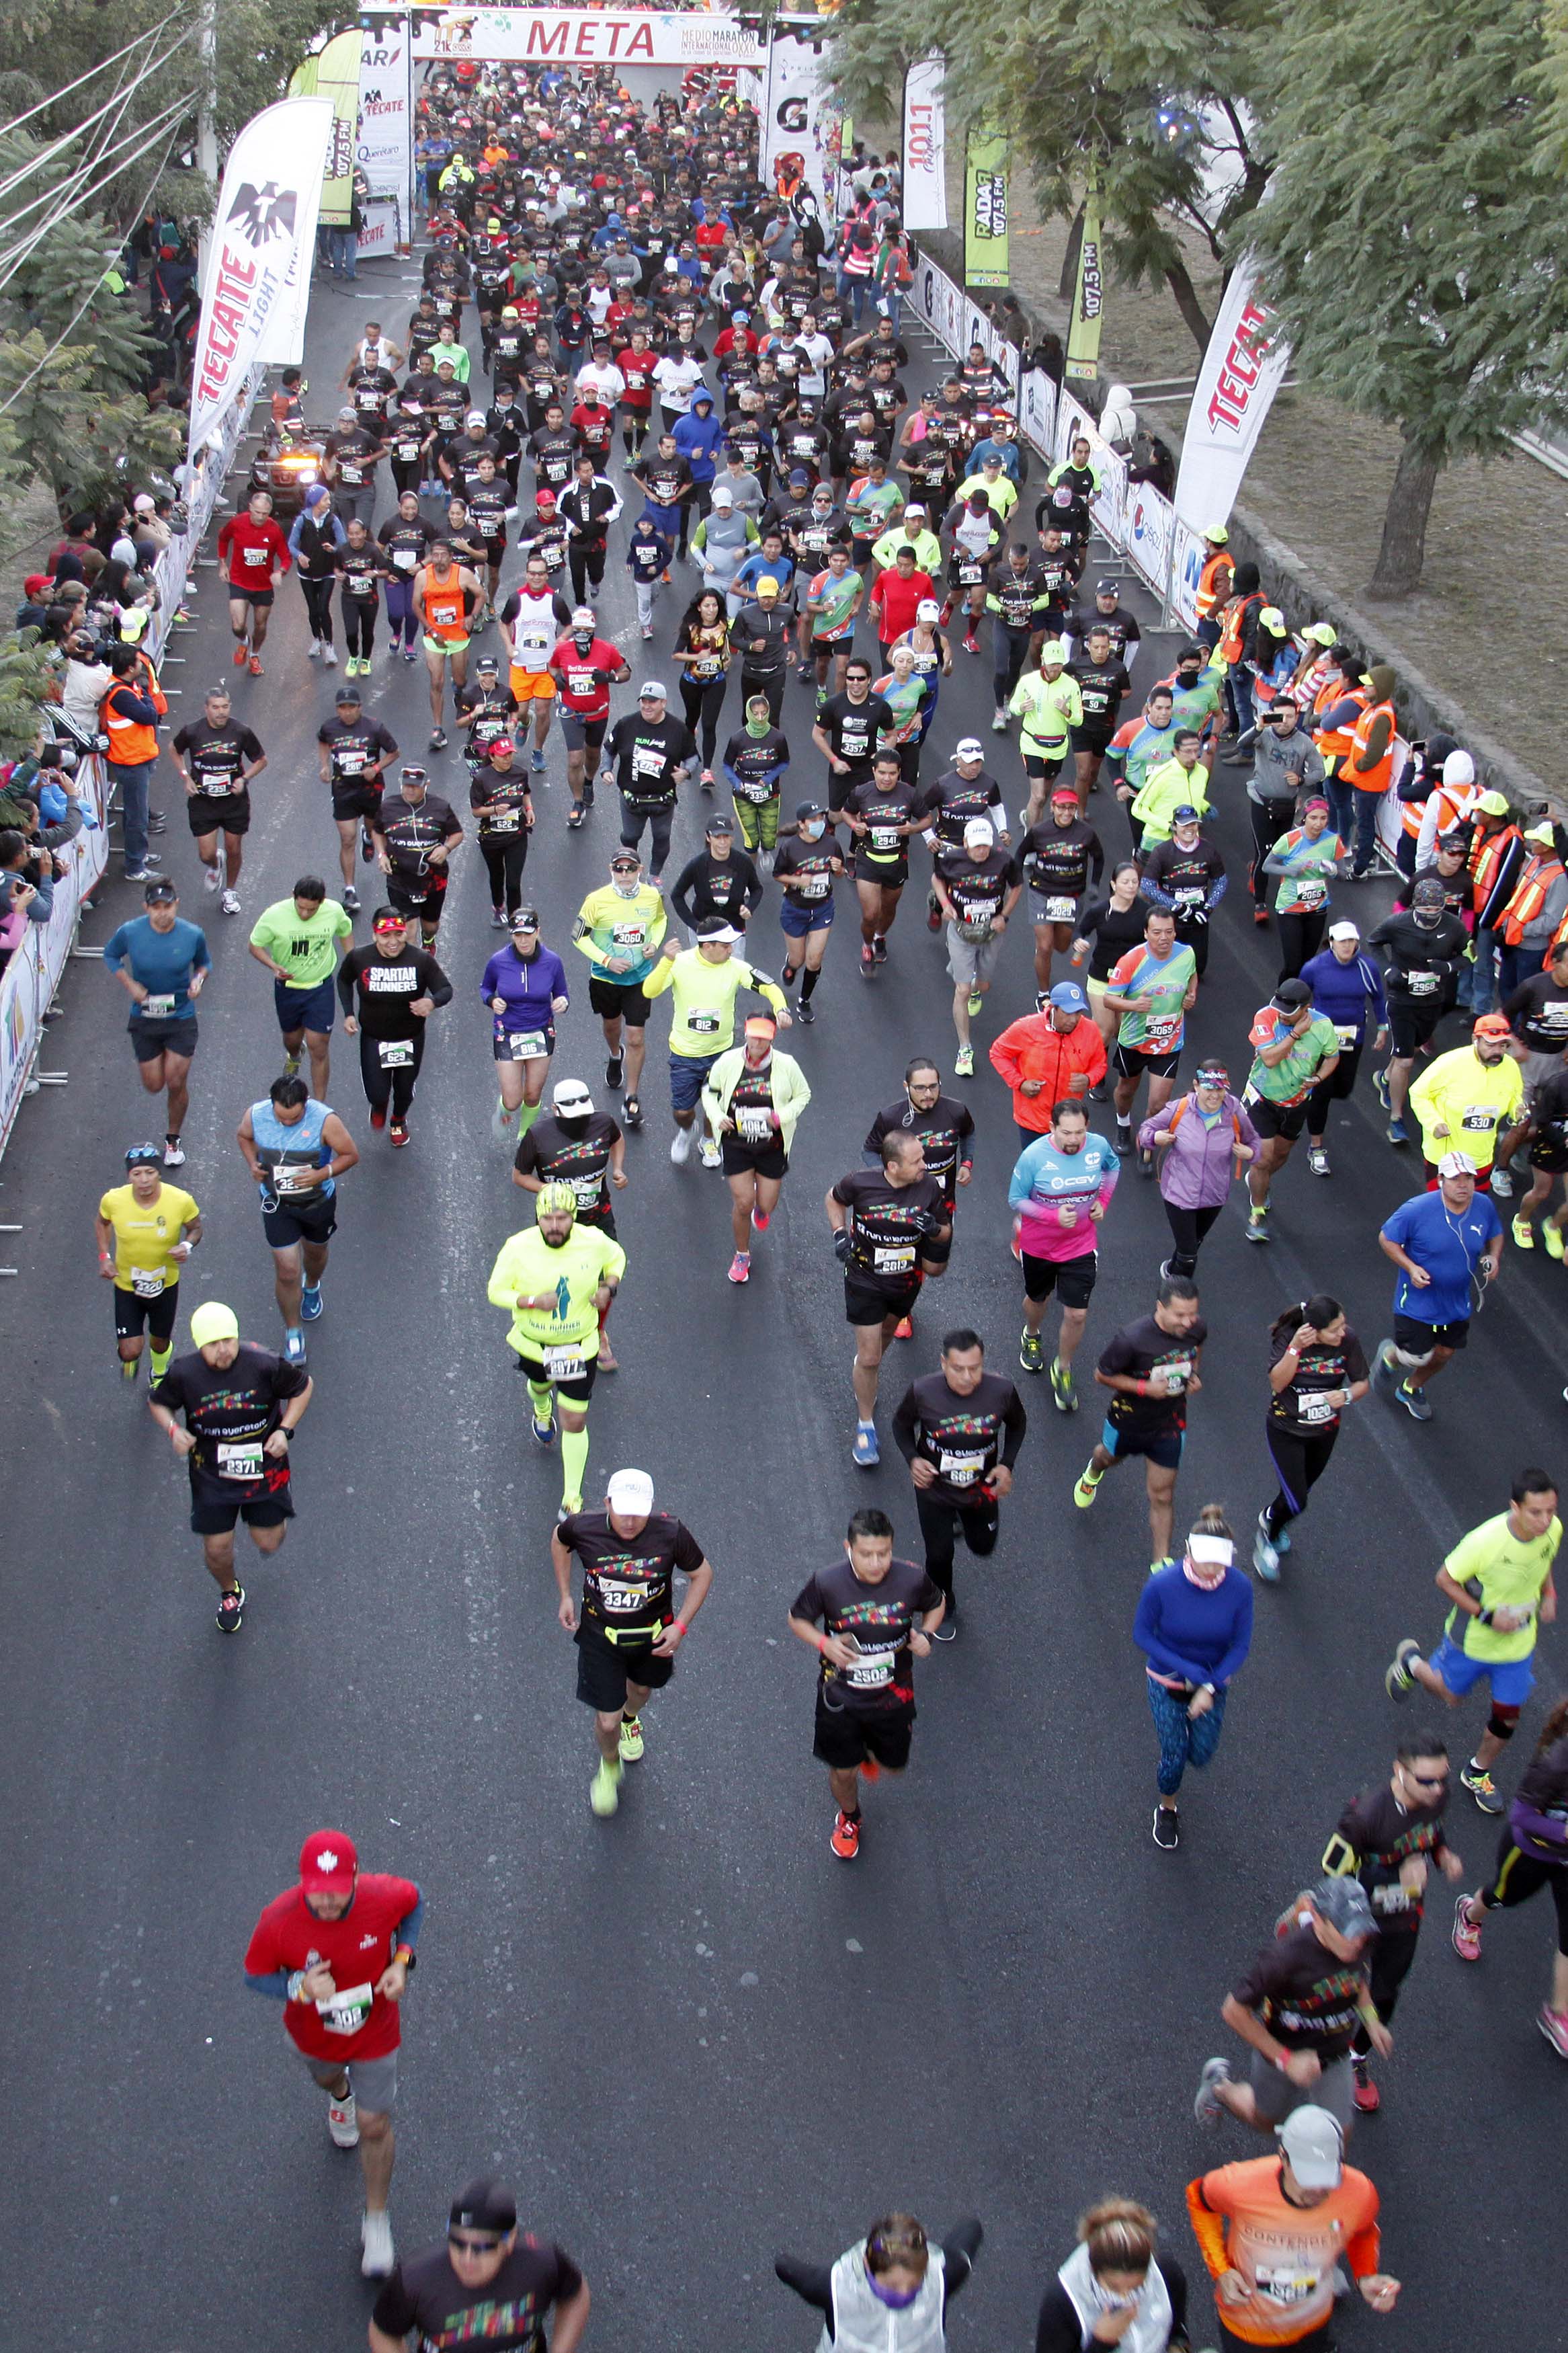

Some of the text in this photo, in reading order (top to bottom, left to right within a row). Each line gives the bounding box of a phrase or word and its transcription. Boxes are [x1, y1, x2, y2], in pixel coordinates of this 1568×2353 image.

[526, 20, 655, 58] META
[682, 30, 712, 42] MEDIO
[681, 42, 731, 51] INTERNACIONAL
[732, 42, 755, 55] OXXO
[366, 101, 405, 116] TECATE
[908, 104, 933, 169] 101.1
[337, 121, 353, 178] 107.5 FM
[991, 176, 1006, 237] 107.5 FM
[1084, 243, 1101, 317] 107.5 FM
[251, 270, 276, 337] LIGHT
[198, 243, 255, 411] TECATE
[1207, 294, 1278, 434] TECAT
[530, 639, 540, 647] 93
[918, 663, 932, 671] 306
[1088, 701, 1099, 709] 50
[845, 742, 864, 753] 3357
[749, 791, 770, 800] 3358
[497, 821, 513, 829] 622
[878, 836, 897, 845] 2941
[1051, 906, 1071, 916] 3029
[618, 933, 641, 943] 3060
[370, 967, 416, 982] SPARTAN
[369, 980, 417, 992] RUNNERS
[696, 1019, 711, 1030] 812
[1150, 1025, 1173, 1035] 3069
[520, 1043, 538, 1055] 816
[387, 1052, 406, 1062] 629
[1470, 1117, 1489, 1128] 530
[1065, 1176, 1096, 1187] CGV
[866, 1230, 882, 1242] run
[204, 1427, 220, 1436] run
[604, 1593, 641, 1608] 3347
